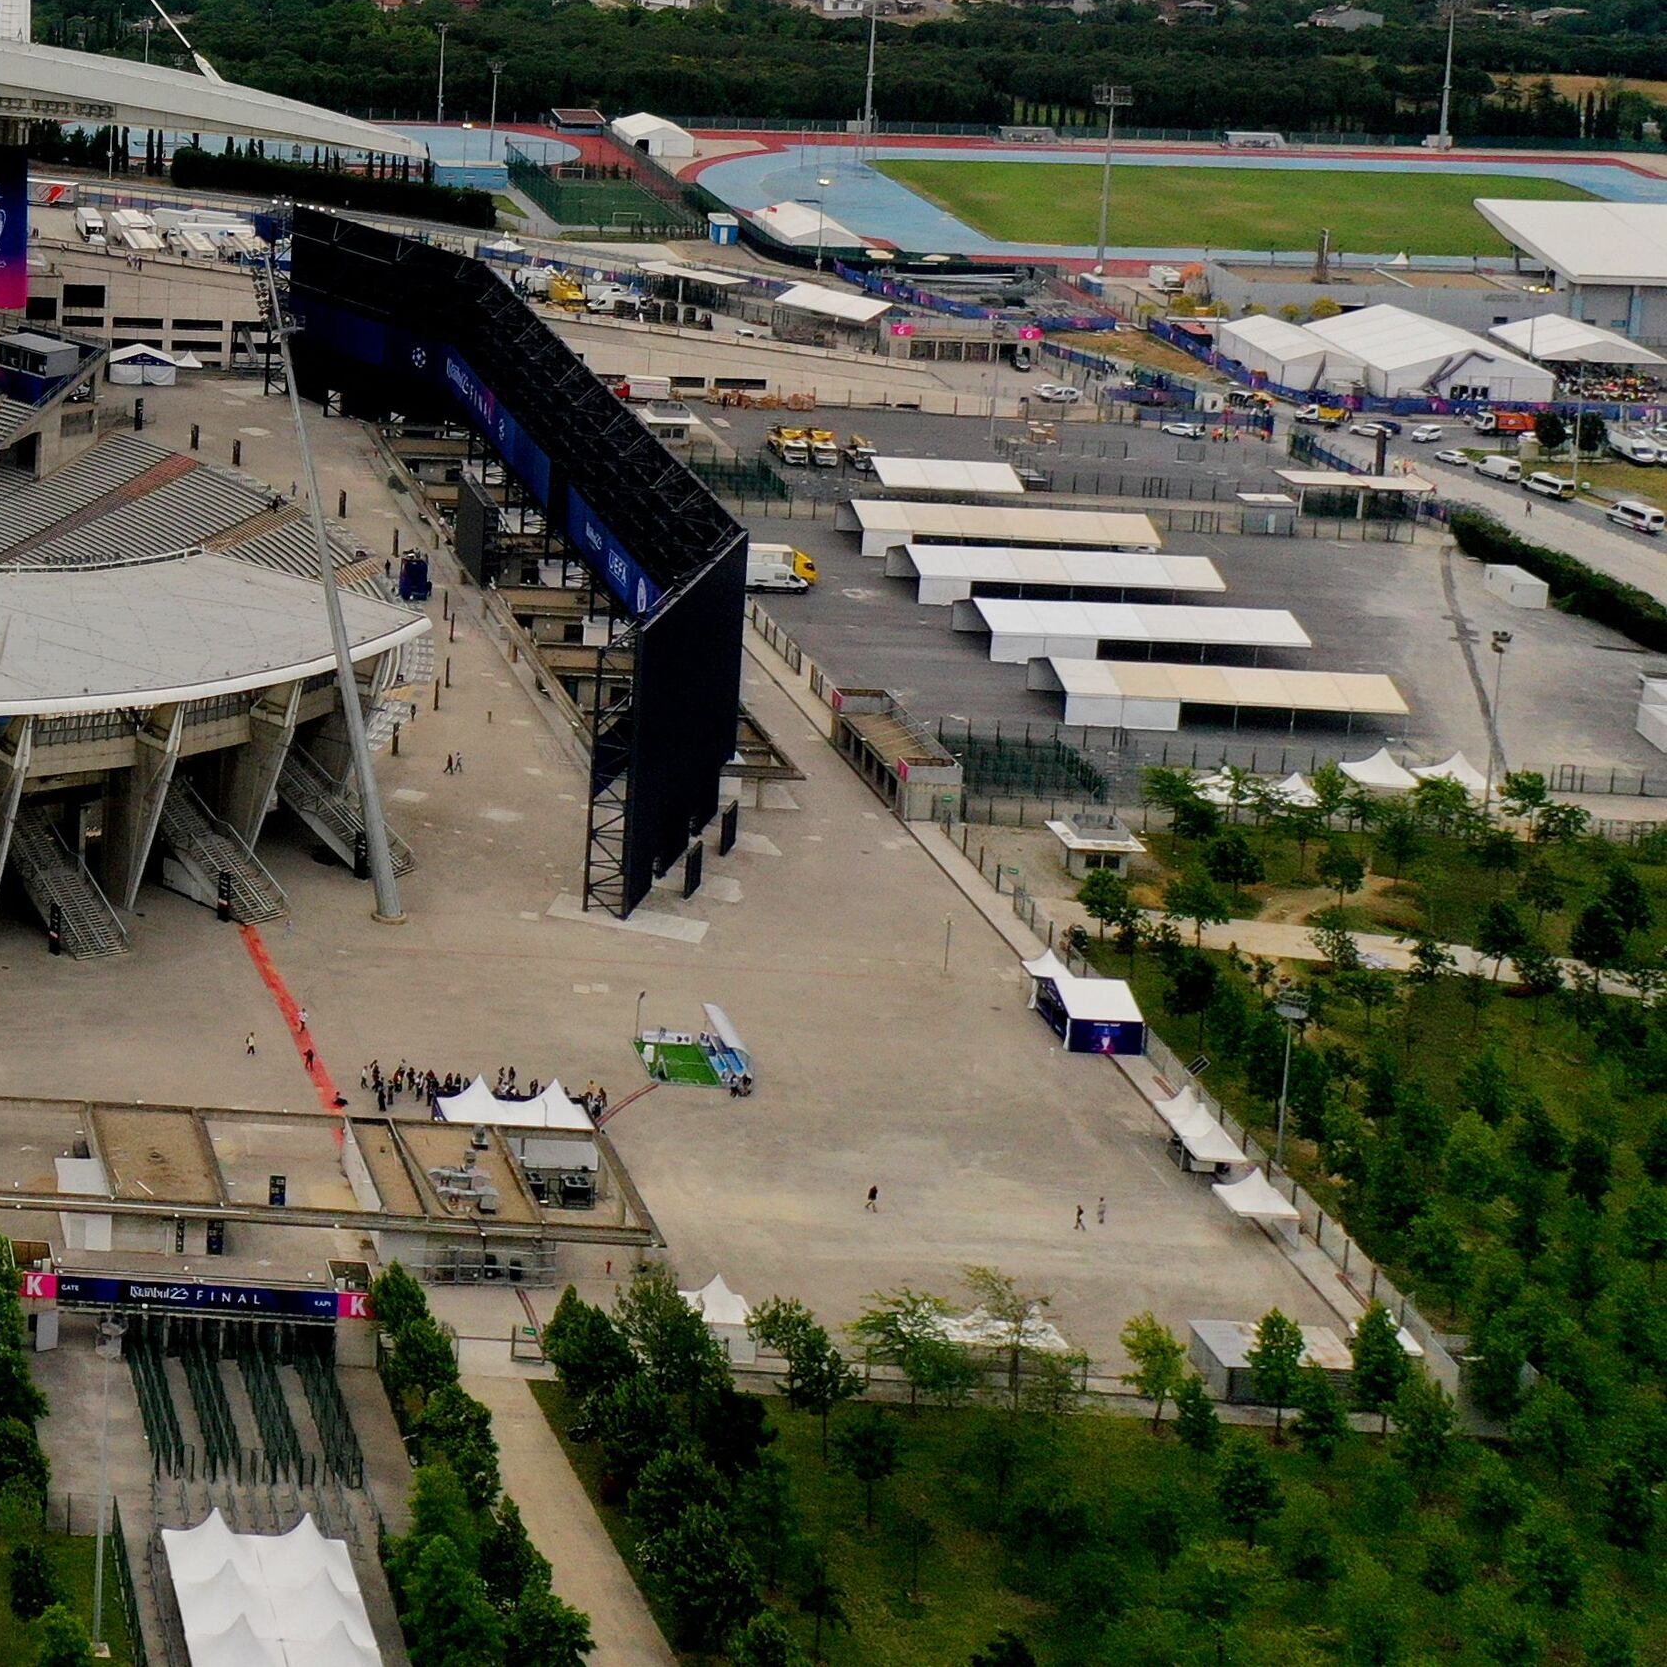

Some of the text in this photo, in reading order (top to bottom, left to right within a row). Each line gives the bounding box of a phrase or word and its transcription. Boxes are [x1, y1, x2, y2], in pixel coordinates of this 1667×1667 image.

[608, 551, 627, 585] UEFA
[26, 1275, 44, 1296] K
[61, 1283, 79, 1291] GATE
[196, 1290, 261, 1305] FINAL
[350, 1295, 367, 1317] K
